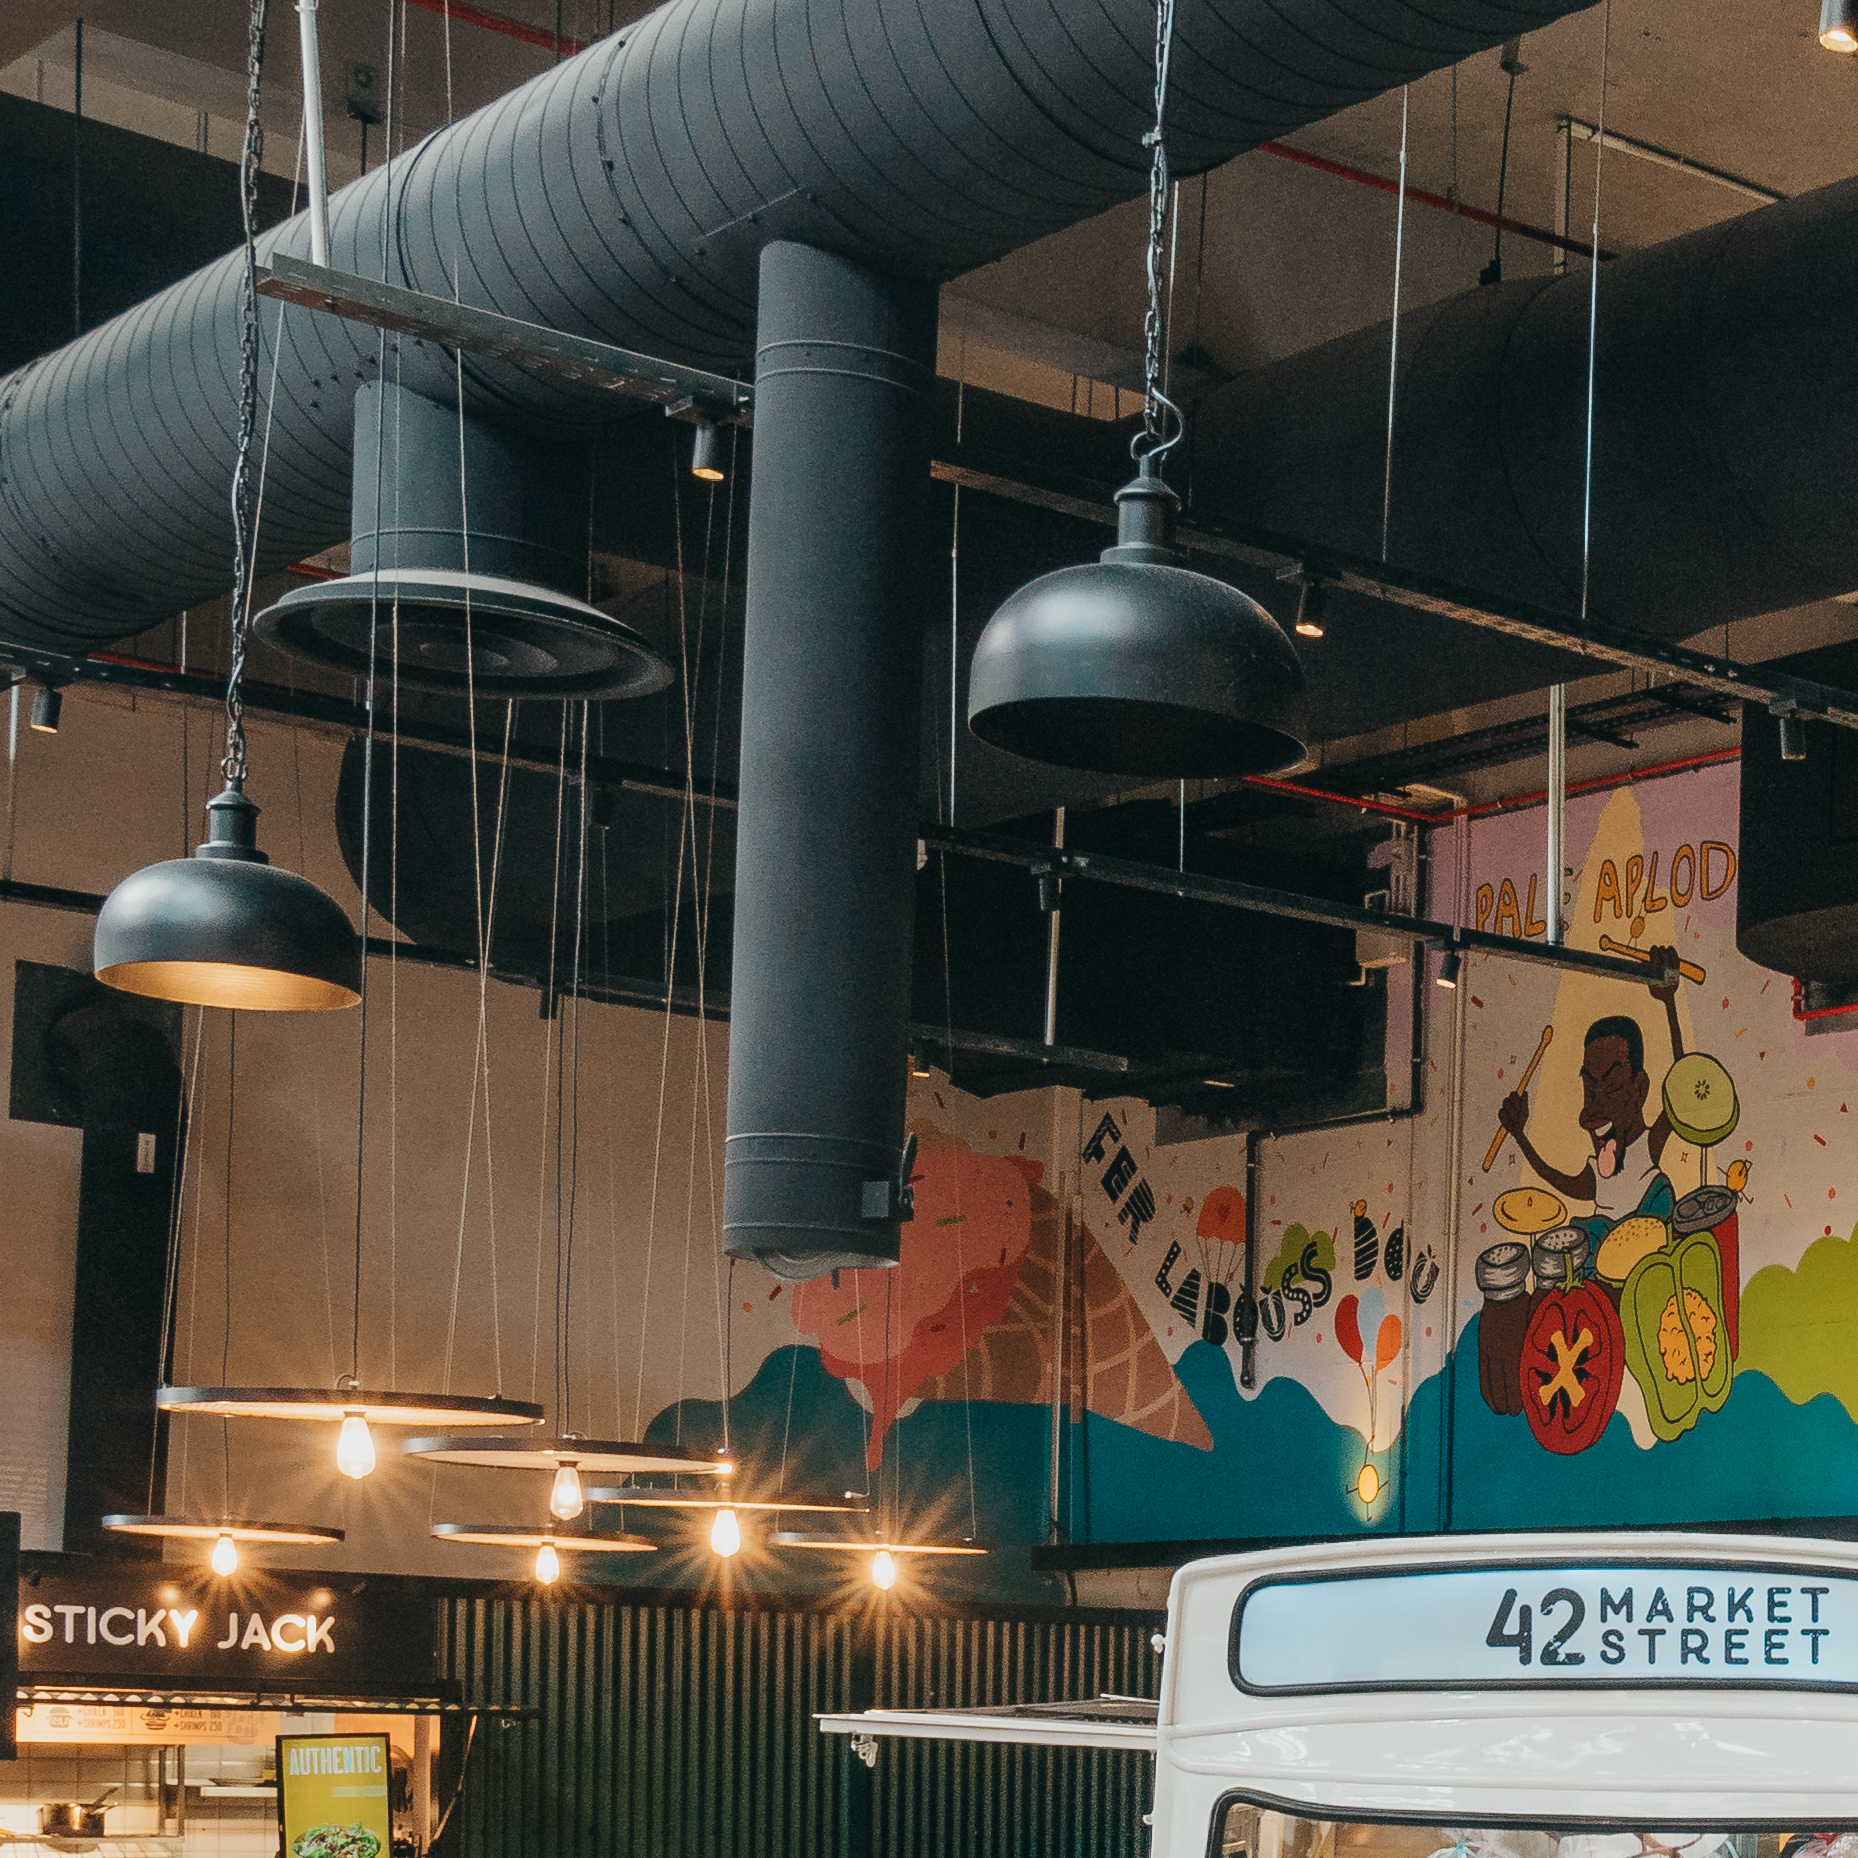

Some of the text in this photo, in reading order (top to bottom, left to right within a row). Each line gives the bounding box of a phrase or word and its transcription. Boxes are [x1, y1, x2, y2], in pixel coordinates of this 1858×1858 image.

[1476, 840, 1737, 939] PAL APLOD
[1081, 1110, 1156, 1246] FER
[22, 1603, 337, 1654] STICKY JACK
[1485, 1587, 1586, 1666] 42
[1599, 1585, 1831, 1624] MARKET
[1599, 1627, 1831, 1666] STREET
[289, 1745, 382, 1776] AUTHENTIC
